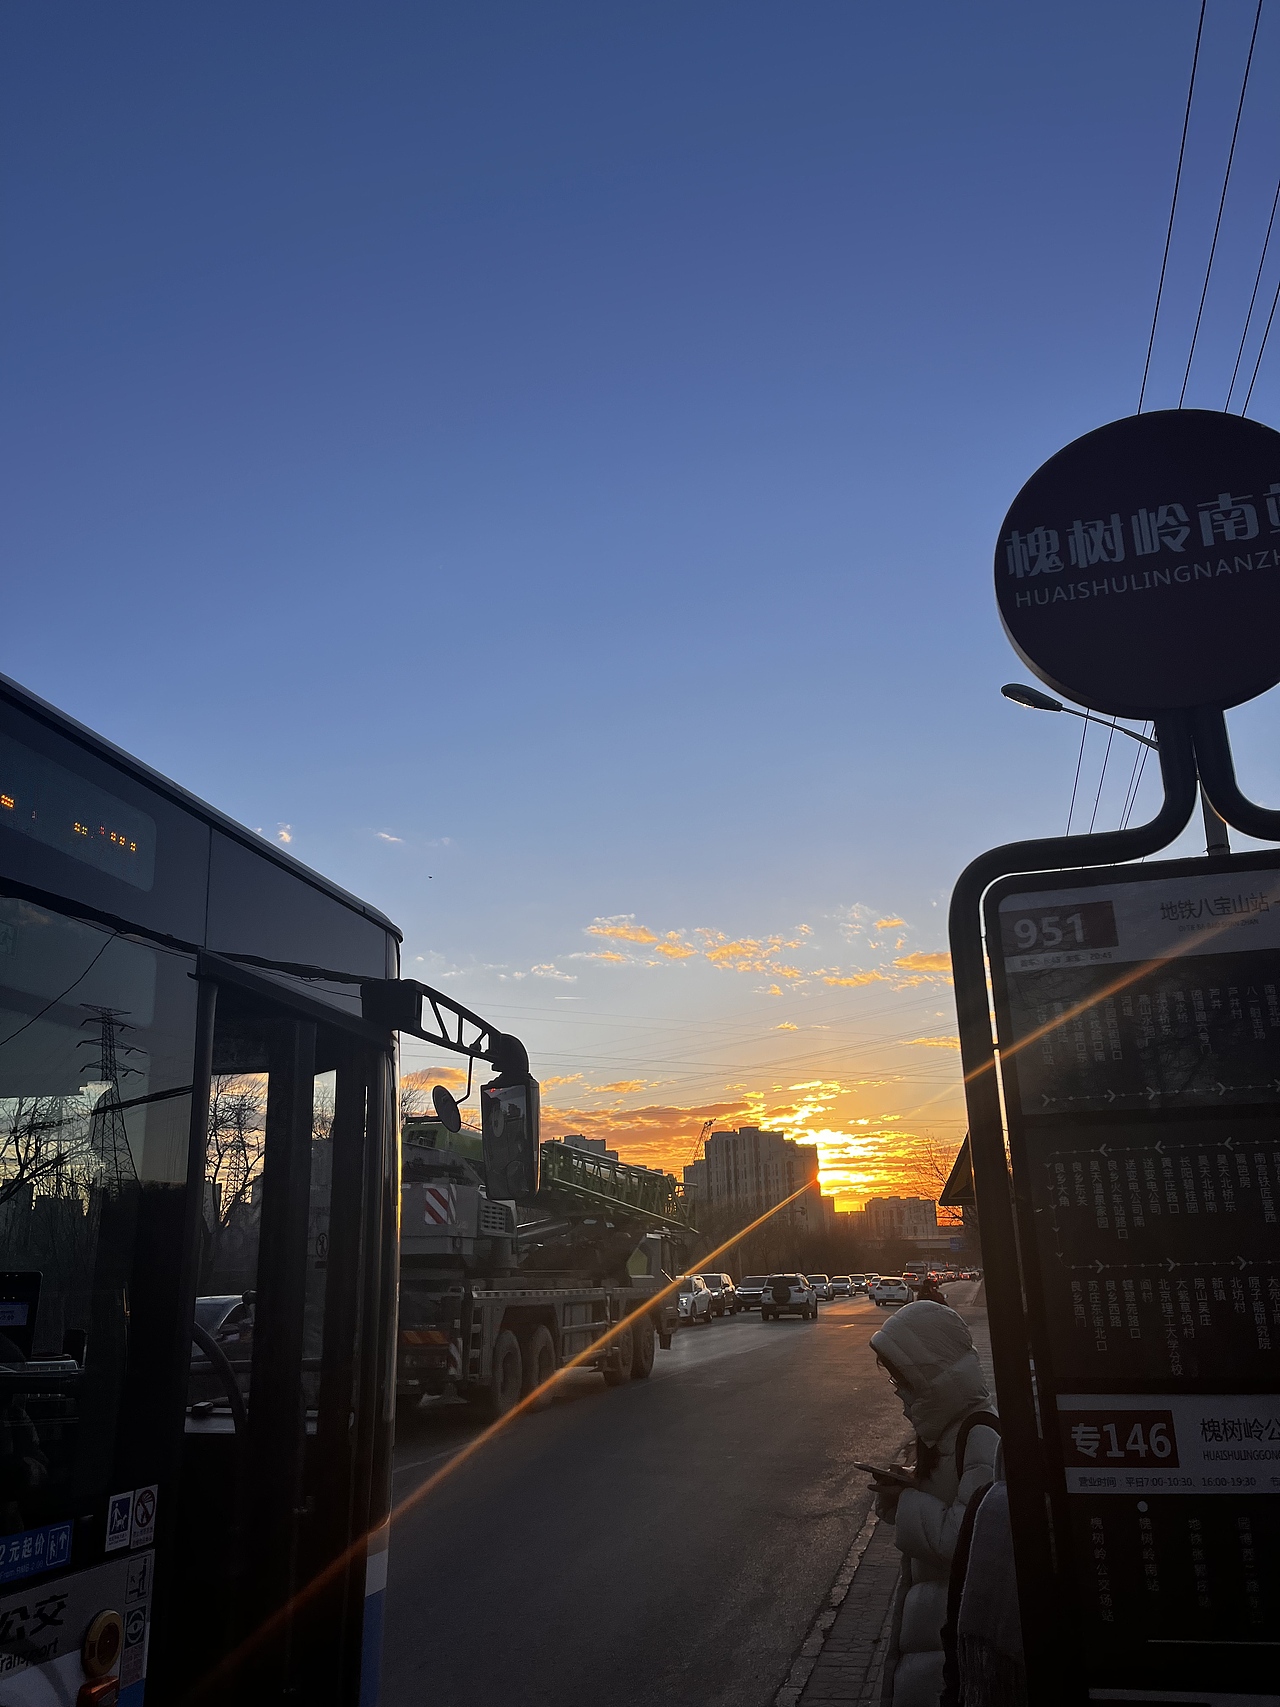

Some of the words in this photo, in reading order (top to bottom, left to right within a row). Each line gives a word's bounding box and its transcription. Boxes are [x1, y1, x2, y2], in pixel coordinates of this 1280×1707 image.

[1013, 911, 1085, 949] 951
[1160, 891, 1270, 921] 地铁八宝山站
[1072, 1161, 1088, 1207] 良乡东关
[1107, 1159, 1129, 1240] 良乡火车站路口
[1124, 1158, 1146, 1228] 送变电公司南
[1142, 1157, 1162, 1216] 送变电公司
[1105, 1279, 1122, 1328] 良乡西路
[1157, 1278, 1184, 1377] 北京理工大学分校
[1247, 1276, 1272, 1350] 原子能研究院
[1070, 1421, 1172, 1459] 专146
[1200, 1417, 1280, 1443] 槐树岭公
[0, 1593, 69, 1645] 公交
